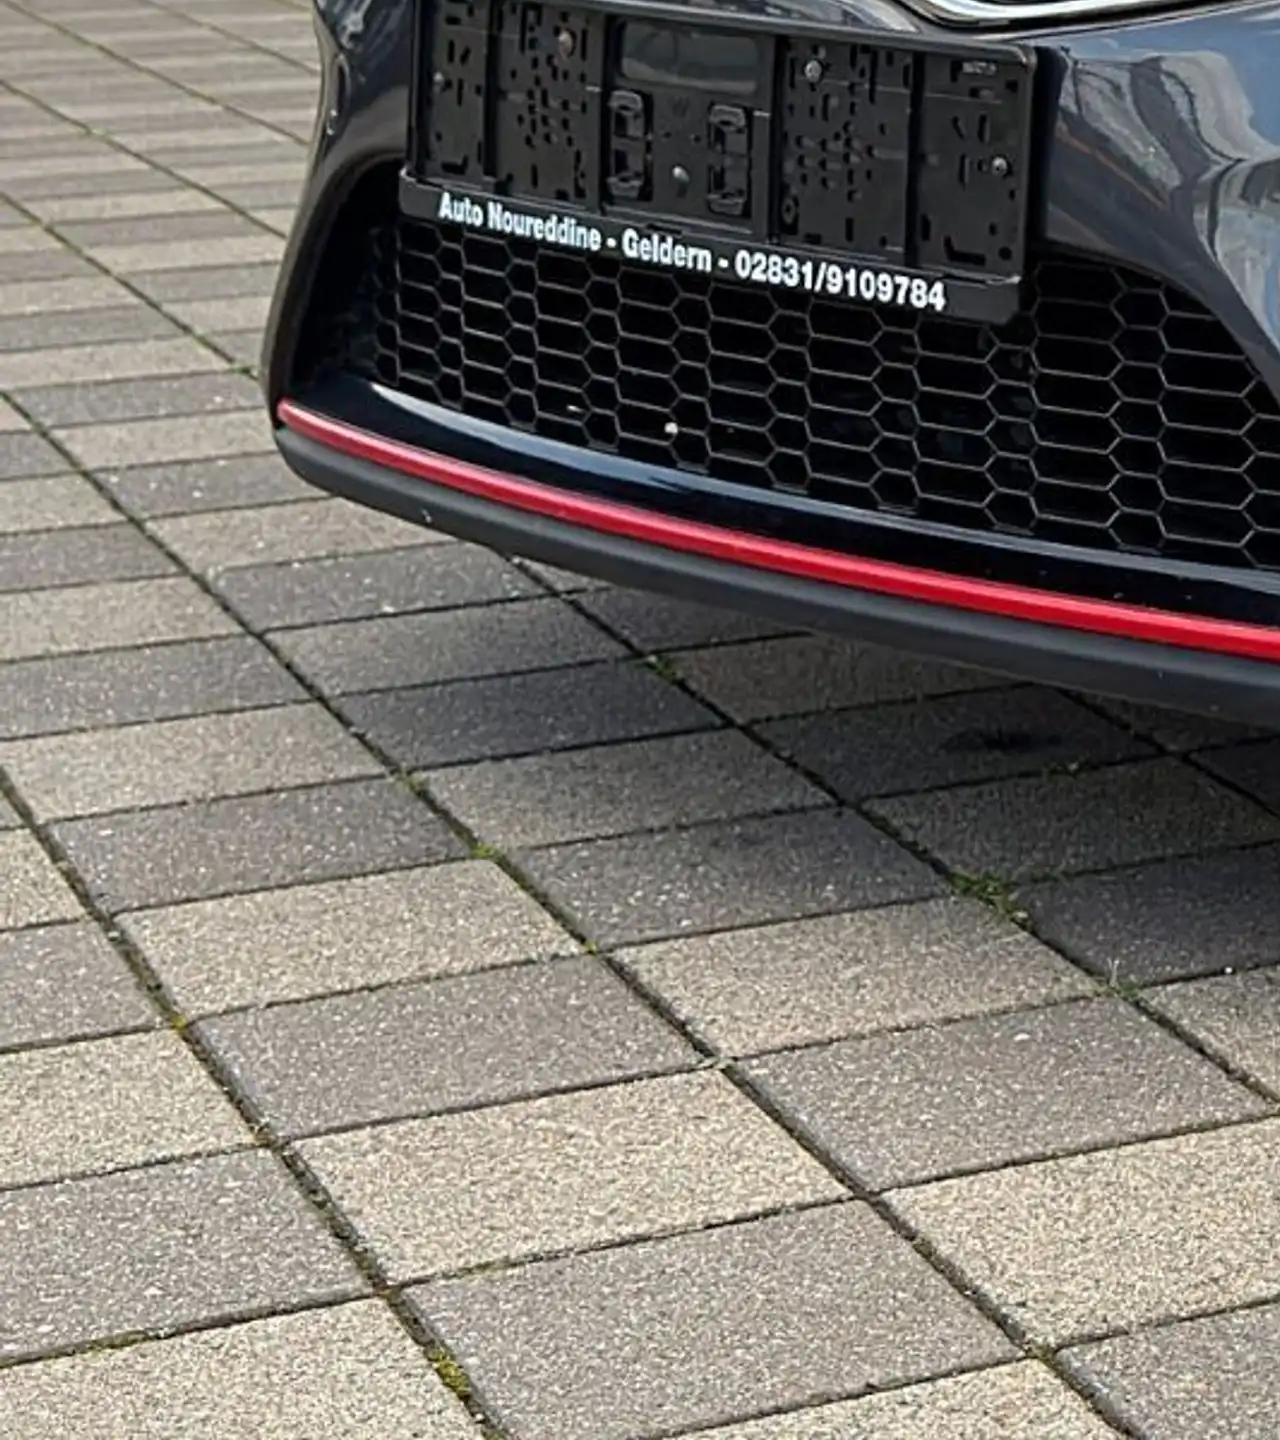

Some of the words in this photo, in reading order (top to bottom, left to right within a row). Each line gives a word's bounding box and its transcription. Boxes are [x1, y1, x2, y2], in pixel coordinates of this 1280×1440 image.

[437, 190, 484, 228] Auto
[487, 200, 603, 252] Noureddine
[622, 227, 712, 274] Geldern
[734, 248, 947, 313] 02831/9109784
